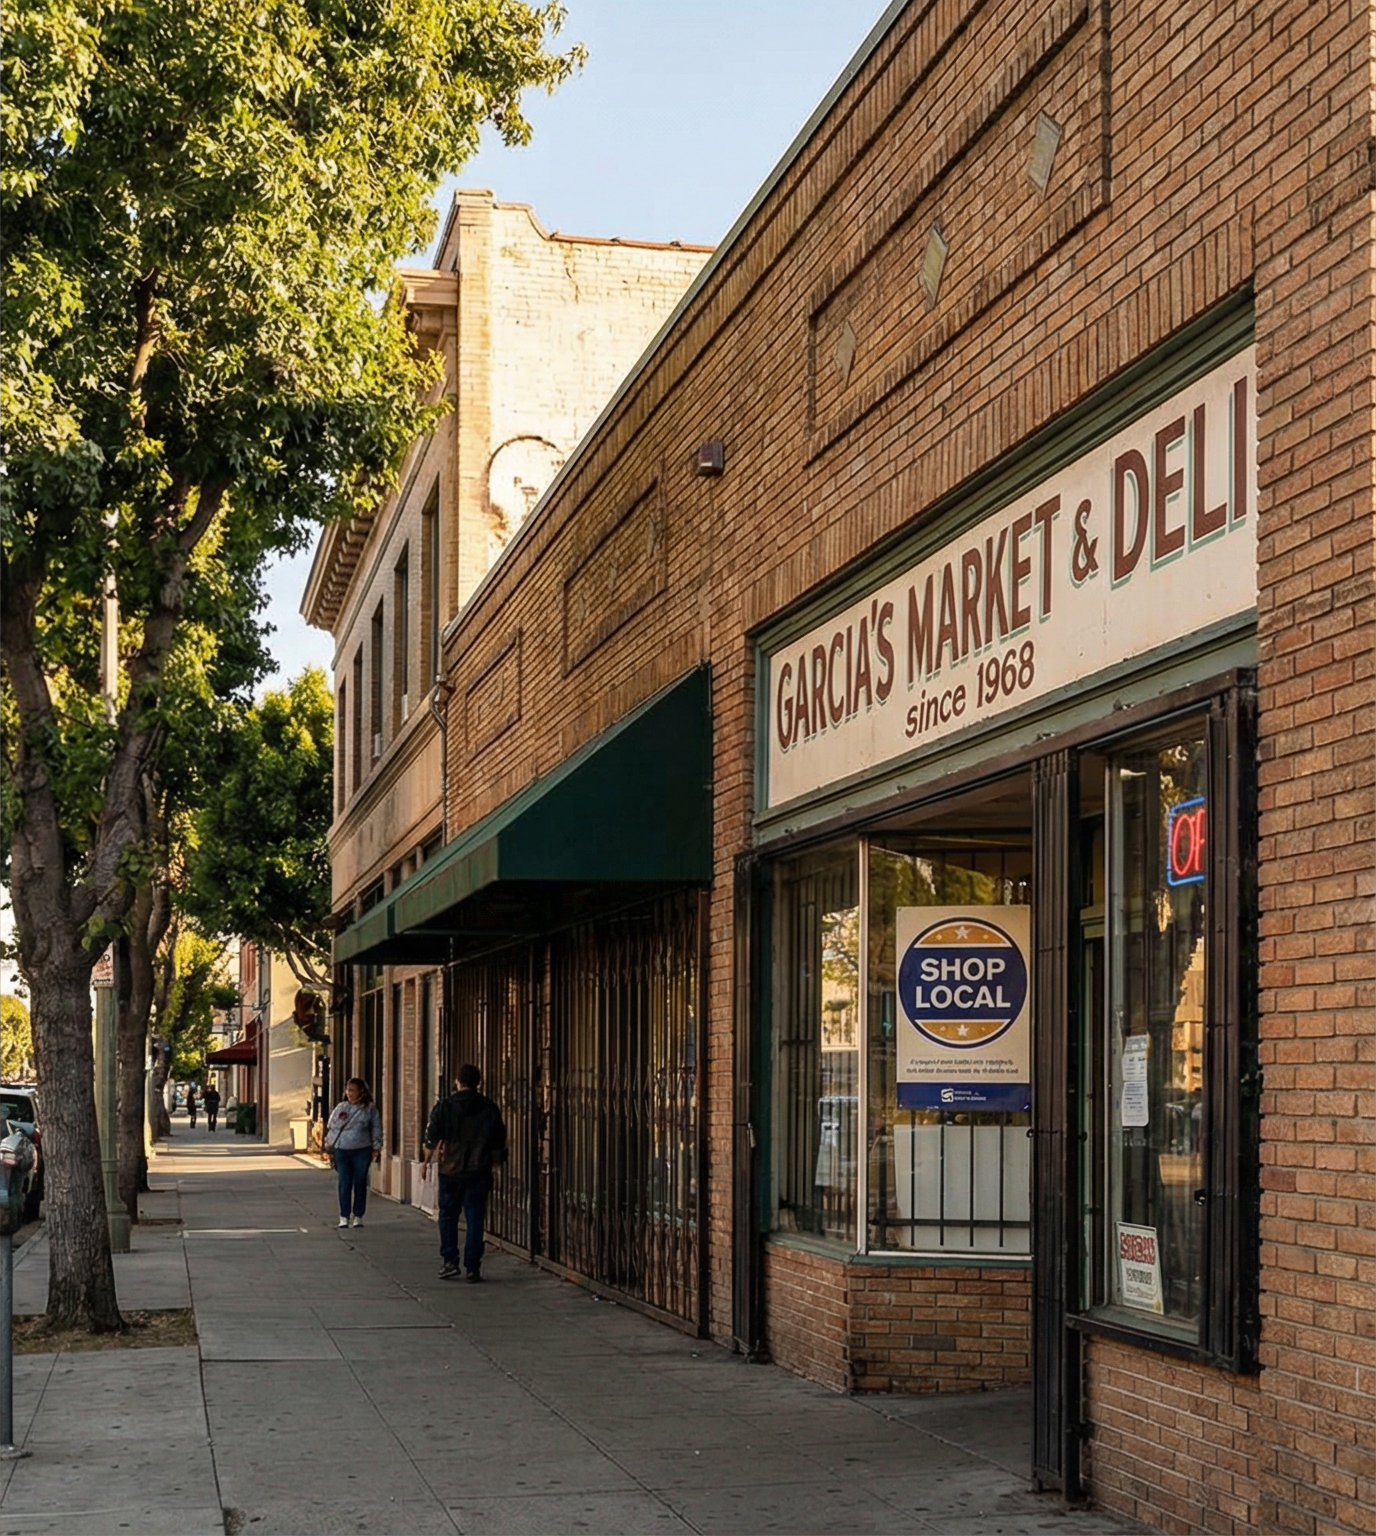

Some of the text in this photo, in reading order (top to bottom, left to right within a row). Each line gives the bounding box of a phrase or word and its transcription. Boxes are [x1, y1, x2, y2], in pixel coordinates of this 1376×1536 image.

[776, 375, 1248, 751] GARCIA'S MARKET & DELI
[904, 639, 1035, 739] since 1968
[915, 985, 1011, 1009] LOCAL
[920, 957, 1006, 982] SHOP
